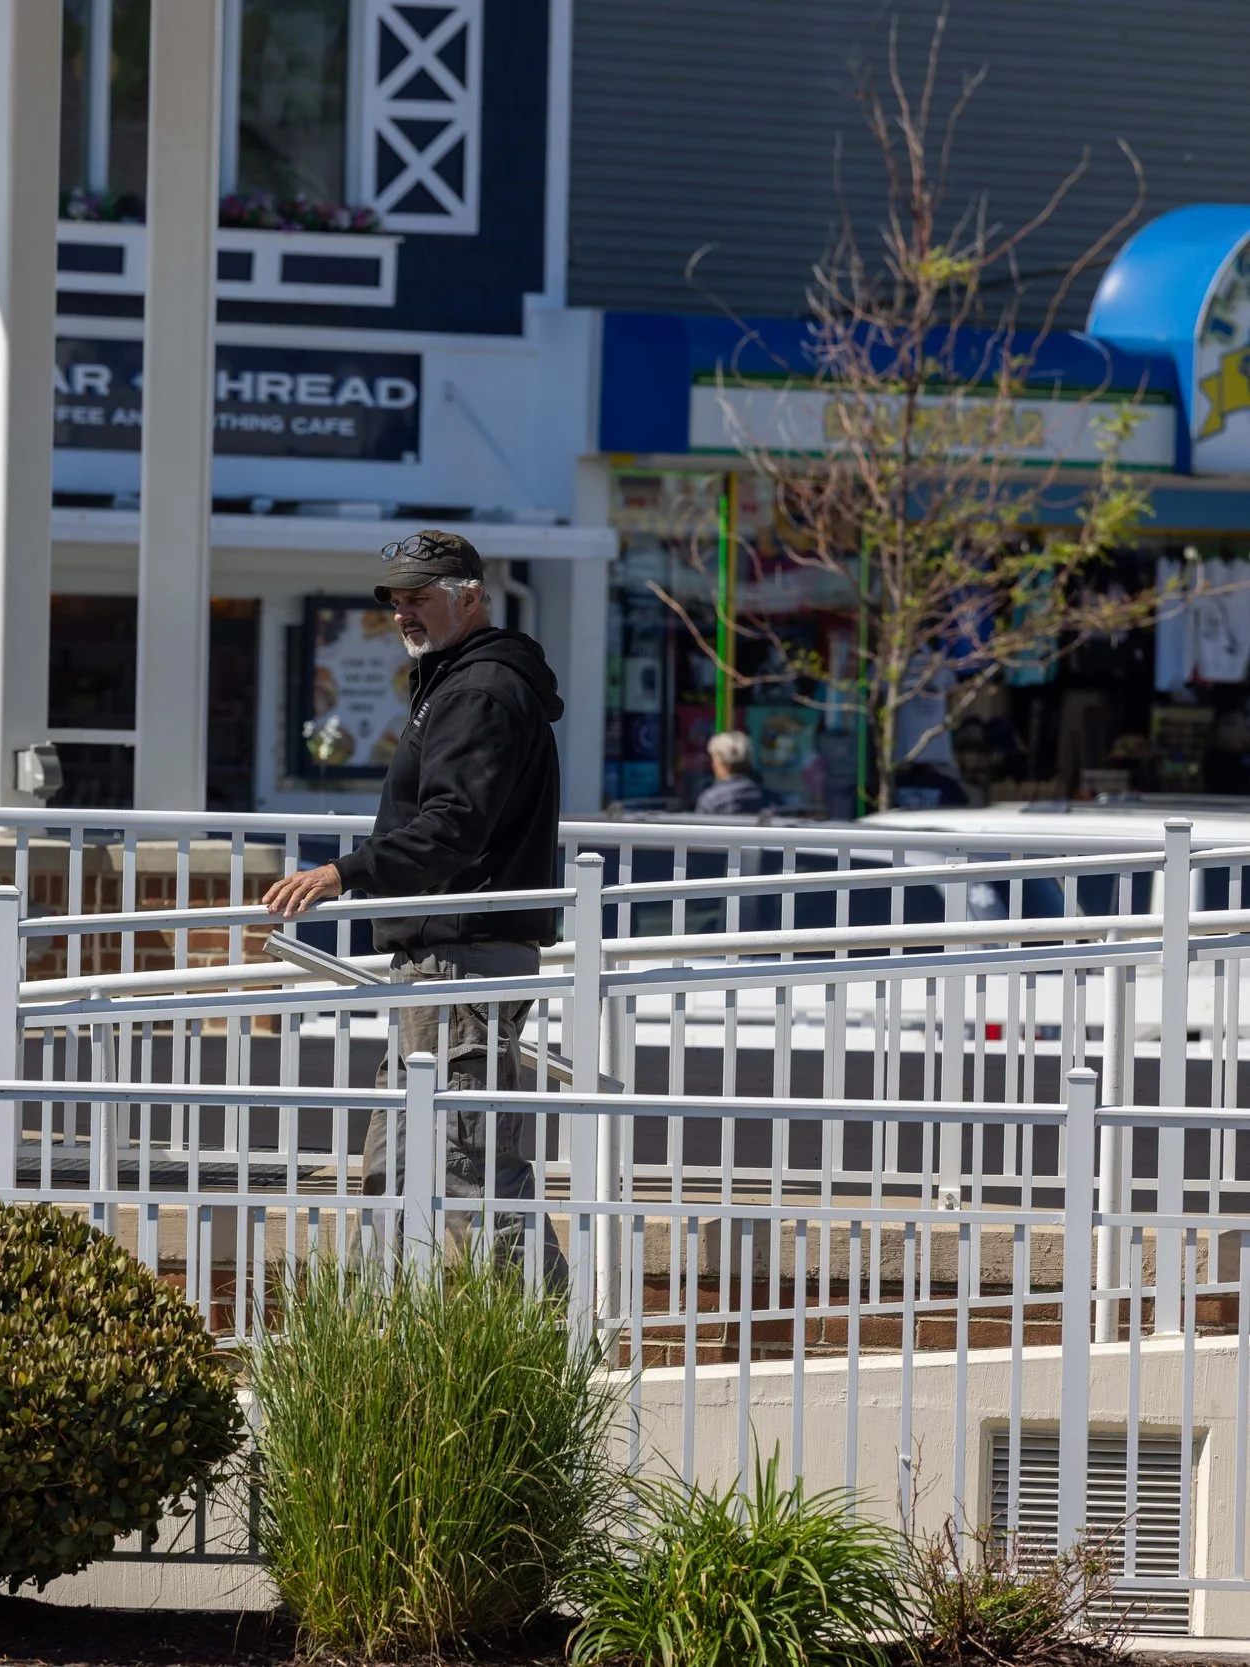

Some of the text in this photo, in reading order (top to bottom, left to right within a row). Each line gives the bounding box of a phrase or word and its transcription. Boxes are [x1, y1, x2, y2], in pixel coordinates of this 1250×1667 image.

[216, 369, 417, 409] HREAD
[213, 412, 285, 435] THING
[290, 415, 356, 437] CAFE
